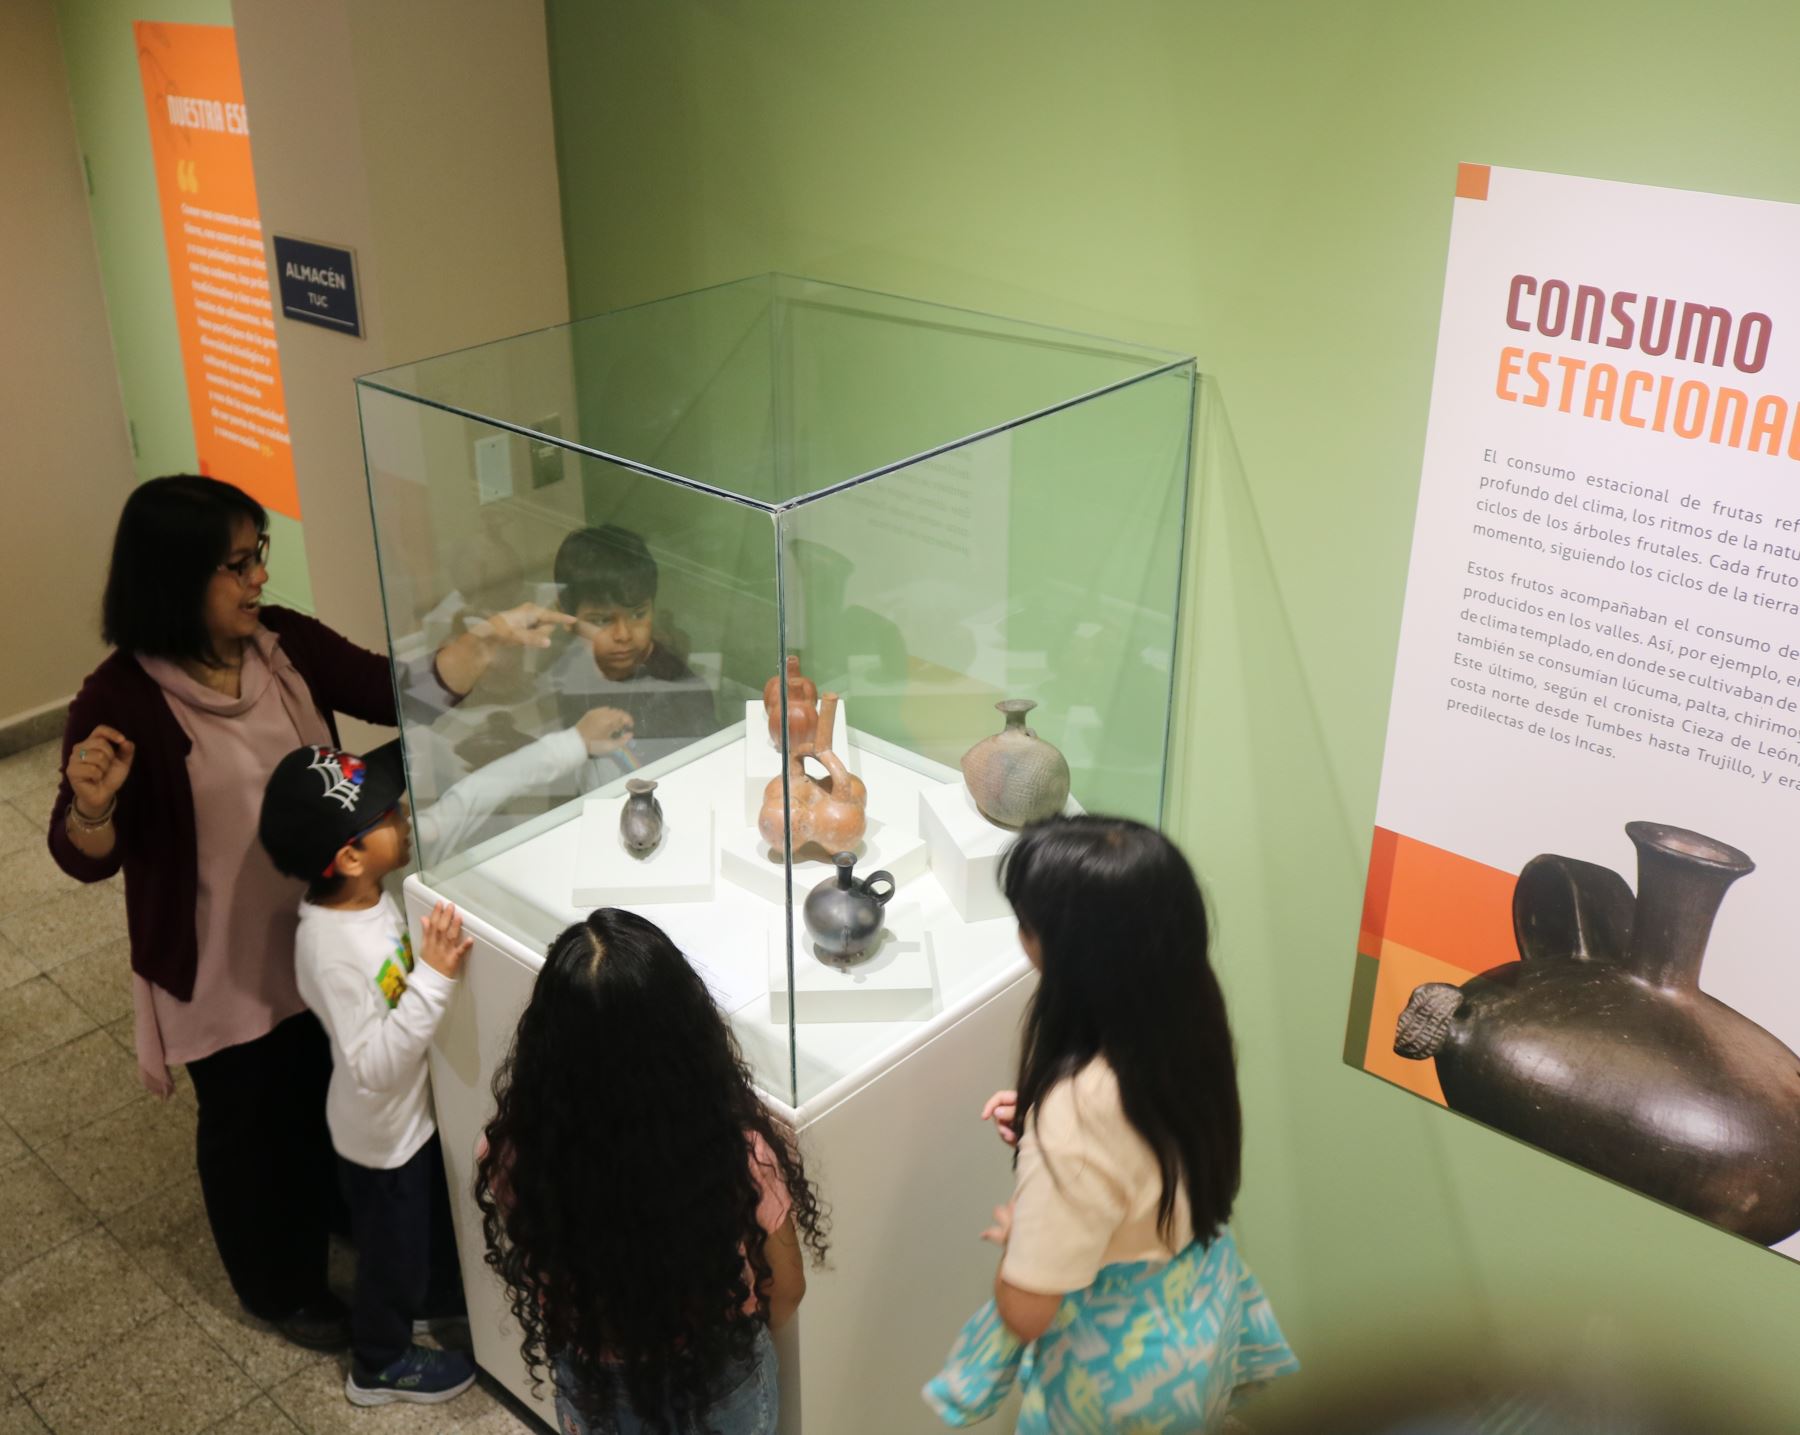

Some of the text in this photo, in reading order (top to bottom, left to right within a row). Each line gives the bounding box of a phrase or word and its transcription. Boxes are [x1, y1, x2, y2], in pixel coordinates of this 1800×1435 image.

[166, 94, 225, 133] NUESTRA
[286, 261, 346, 290] ALMACÉN
[308, 292, 329, 308] TUC
[1506, 274, 1773, 374] CONSUMO
[1479, 475, 1800, 562] profundo del clima, los ritmos de la natu
[1483, 447, 1800, 534] El consumo estacional de frutas ref
[1472, 523, 1800, 616] momento, siguiendo los ciclos de la tierra
[1475, 498, 1800, 589] ciclos de los árboles frutales. Cada fruto
[1462, 587, 1545, 618] producidos
[1546, 609, 1566, 624] en
[1568, 611, 1592, 631] los
[1594, 622, 1644, 646] valles.
[1646, 634, 1675, 656] Así,
[1677, 645, 1708, 662] por
[1709, 652, 1782, 685] ejemplo,
[1466, 560, 1800, 661] Estos frutos acompañaban el consumo de
[1453, 651, 1483, 672] Este
[1488, 662, 1538, 690] último,
[1543, 680, 1588, 703] según
[1592, 695, 1608, 709] el
[1612, 701, 1676, 729] cronista
[1680, 718, 1725, 743] Cieza
[1729, 734, 1752, 751] de
[1456, 631, 1516, 658] también
[1517, 649, 1535, 664] se
[1537, 655, 1619, 688] consumían
[1621, 676, 1682, 708] lúcuma,
[1684, 698, 1730, 721] palta,
[1459, 607, 1798, 713] de clima templado, en donde se cultivaban de
[1446, 698, 1616, 759] predilectas de los Incas.
[1449, 676, 1487, 696] costa
[1491, 689, 1531, 709] norte
[1534, 700, 1580, 724] desde
[1585, 713, 1643, 743] Tumbes
[1647, 732, 1691, 758] hasta
[1696, 746, 1756, 779] Trujillo,
[1760, 769, 1773, 785] y
